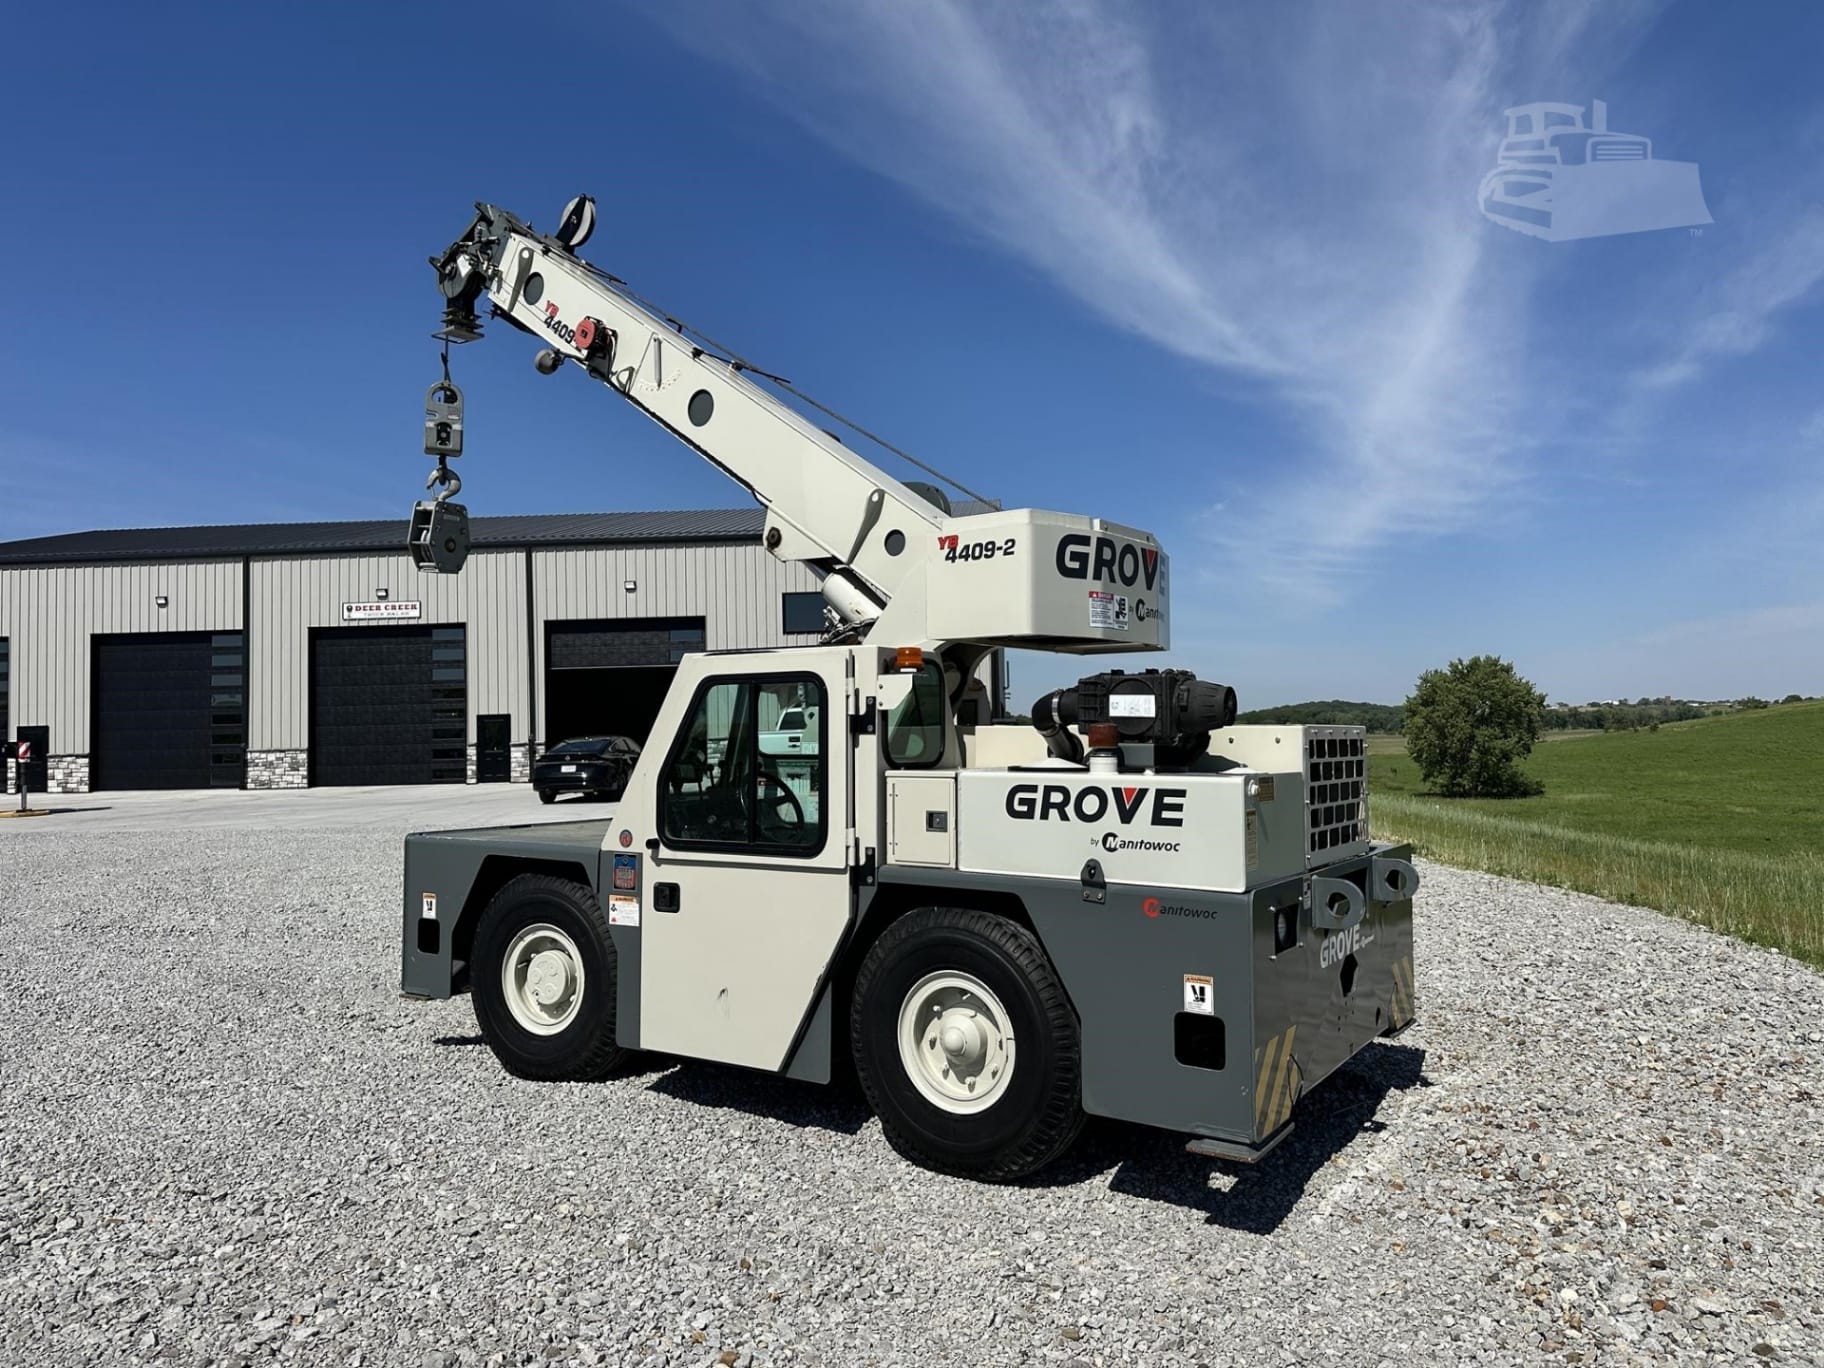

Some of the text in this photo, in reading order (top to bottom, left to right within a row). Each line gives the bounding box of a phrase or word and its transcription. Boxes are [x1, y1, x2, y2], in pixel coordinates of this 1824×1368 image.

[545, 300, 560, 318] YB
[544, 316, 576, 344] 4409
[938, 534, 959, 550] YB
[945, 538, 1016, 563] 4409-2
[1006, 784, 1187, 827] GROVE
[1091, 832, 1181, 853] by Manitowoc
[1320, 923, 1360, 969] GROVE
